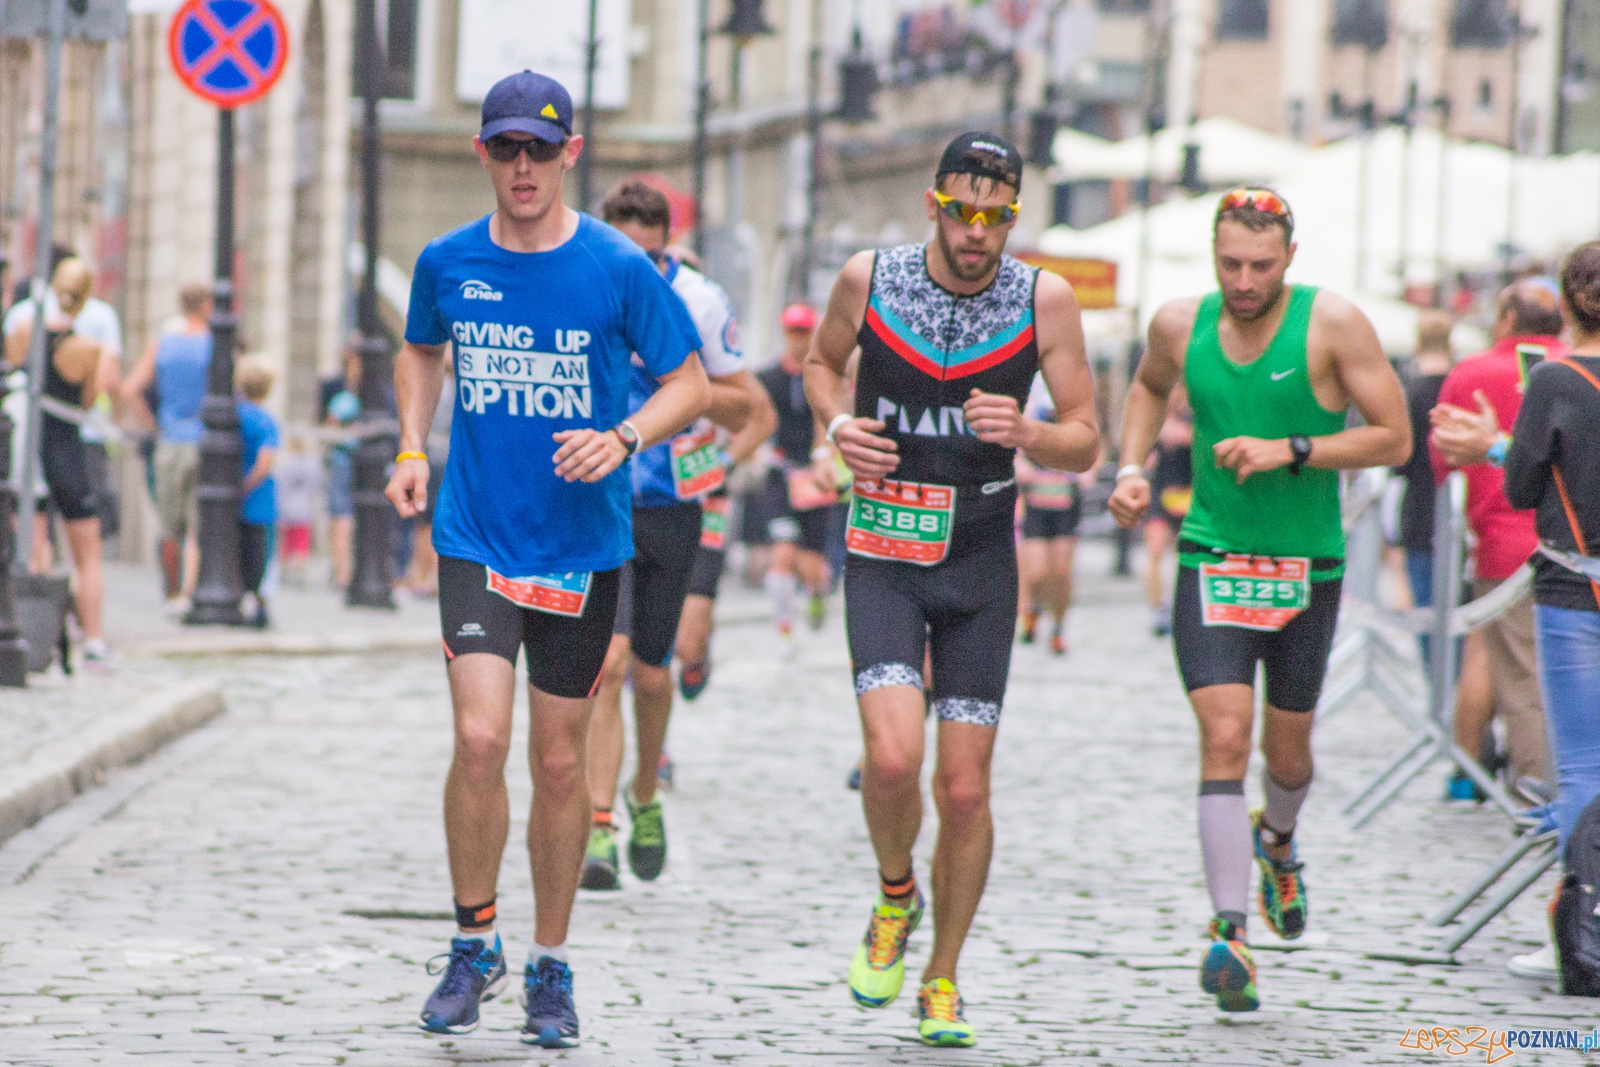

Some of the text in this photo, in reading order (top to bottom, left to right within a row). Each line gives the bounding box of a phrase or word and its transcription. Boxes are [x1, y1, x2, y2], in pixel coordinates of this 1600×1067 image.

[463, 286, 503, 301] Enea
[452, 321, 591, 353] GIVING UP
[487, 354, 536, 376] NOT
[551, 360, 584, 380] AN
[459, 378, 592, 418] OPTION
[861, 503, 938, 532] 3388
[1214, 580, 1294, 599] 3325
